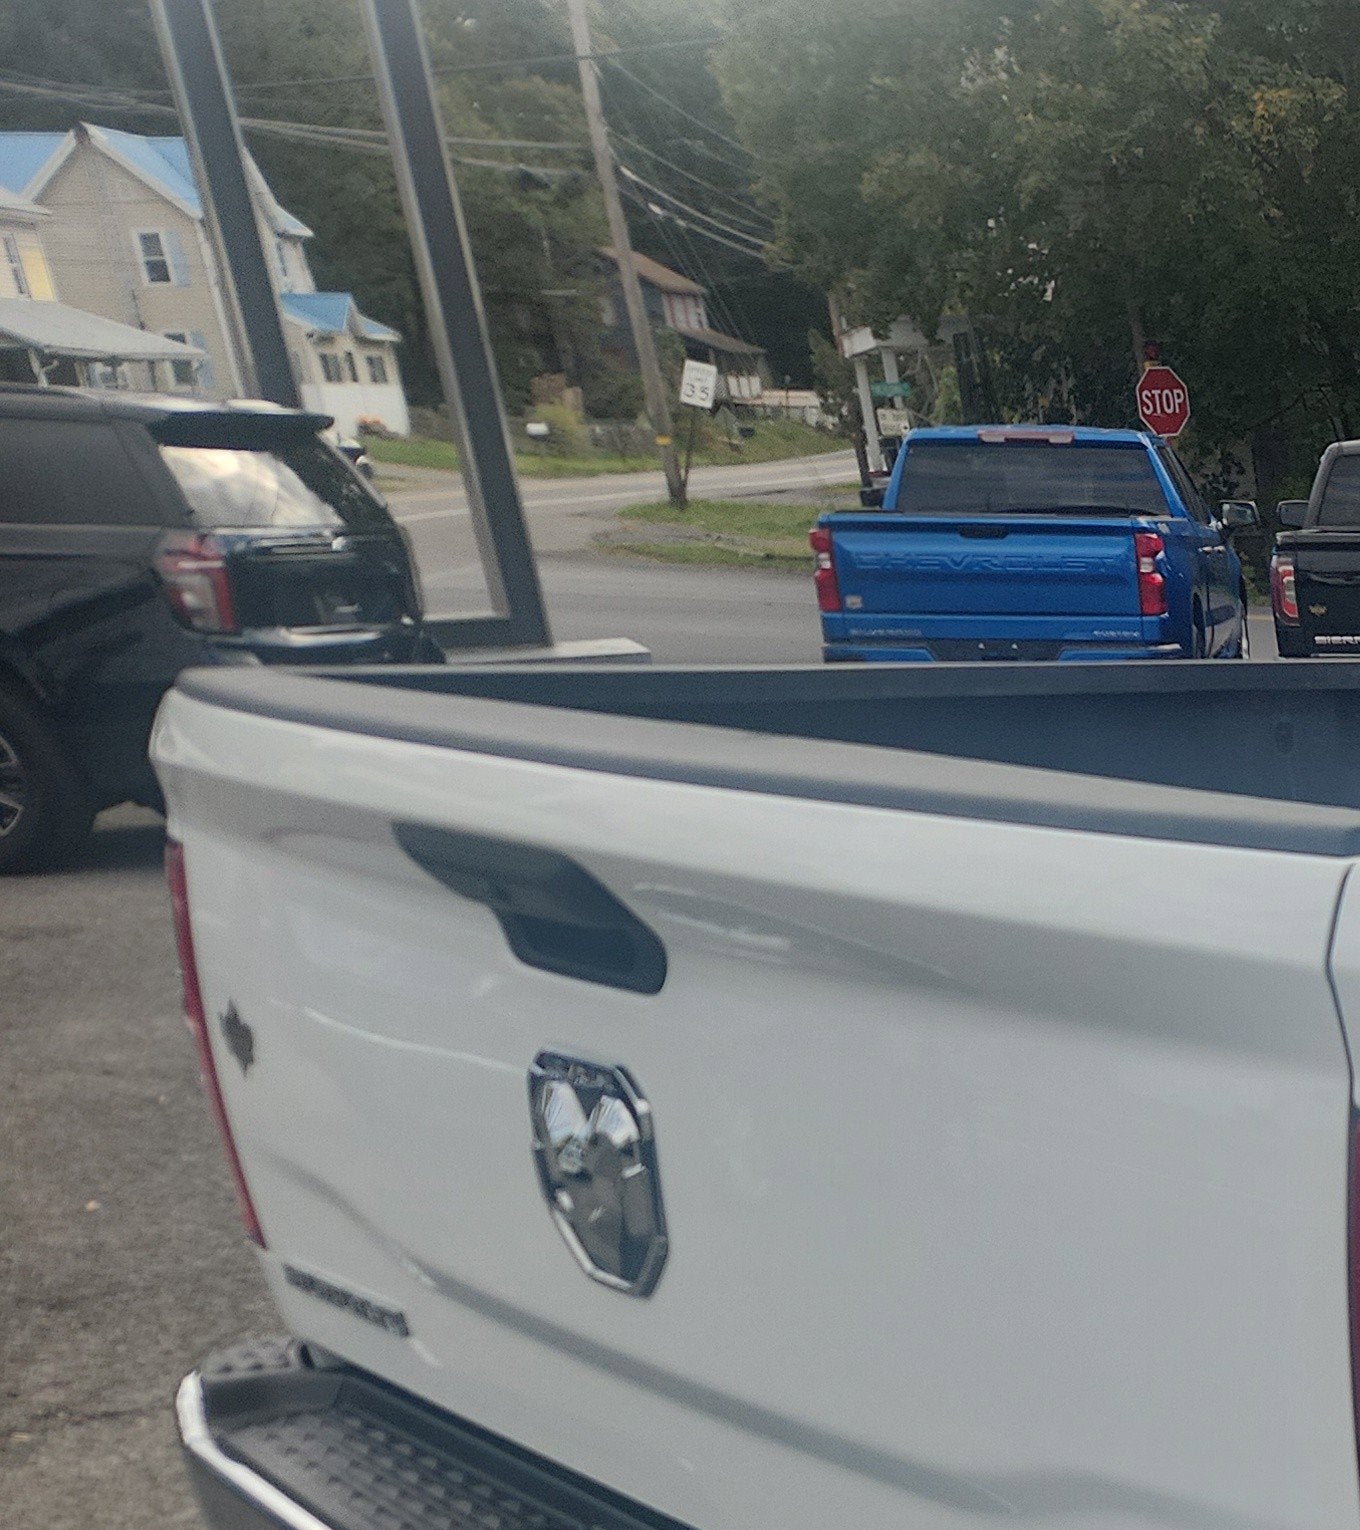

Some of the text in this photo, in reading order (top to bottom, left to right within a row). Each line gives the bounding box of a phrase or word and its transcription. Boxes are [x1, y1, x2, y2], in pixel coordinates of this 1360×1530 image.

[684, 383, 709, 401] 35
[1142, 389, 1185, 416] STOP
[855, 552, 1118, 573] CHEVROLET
